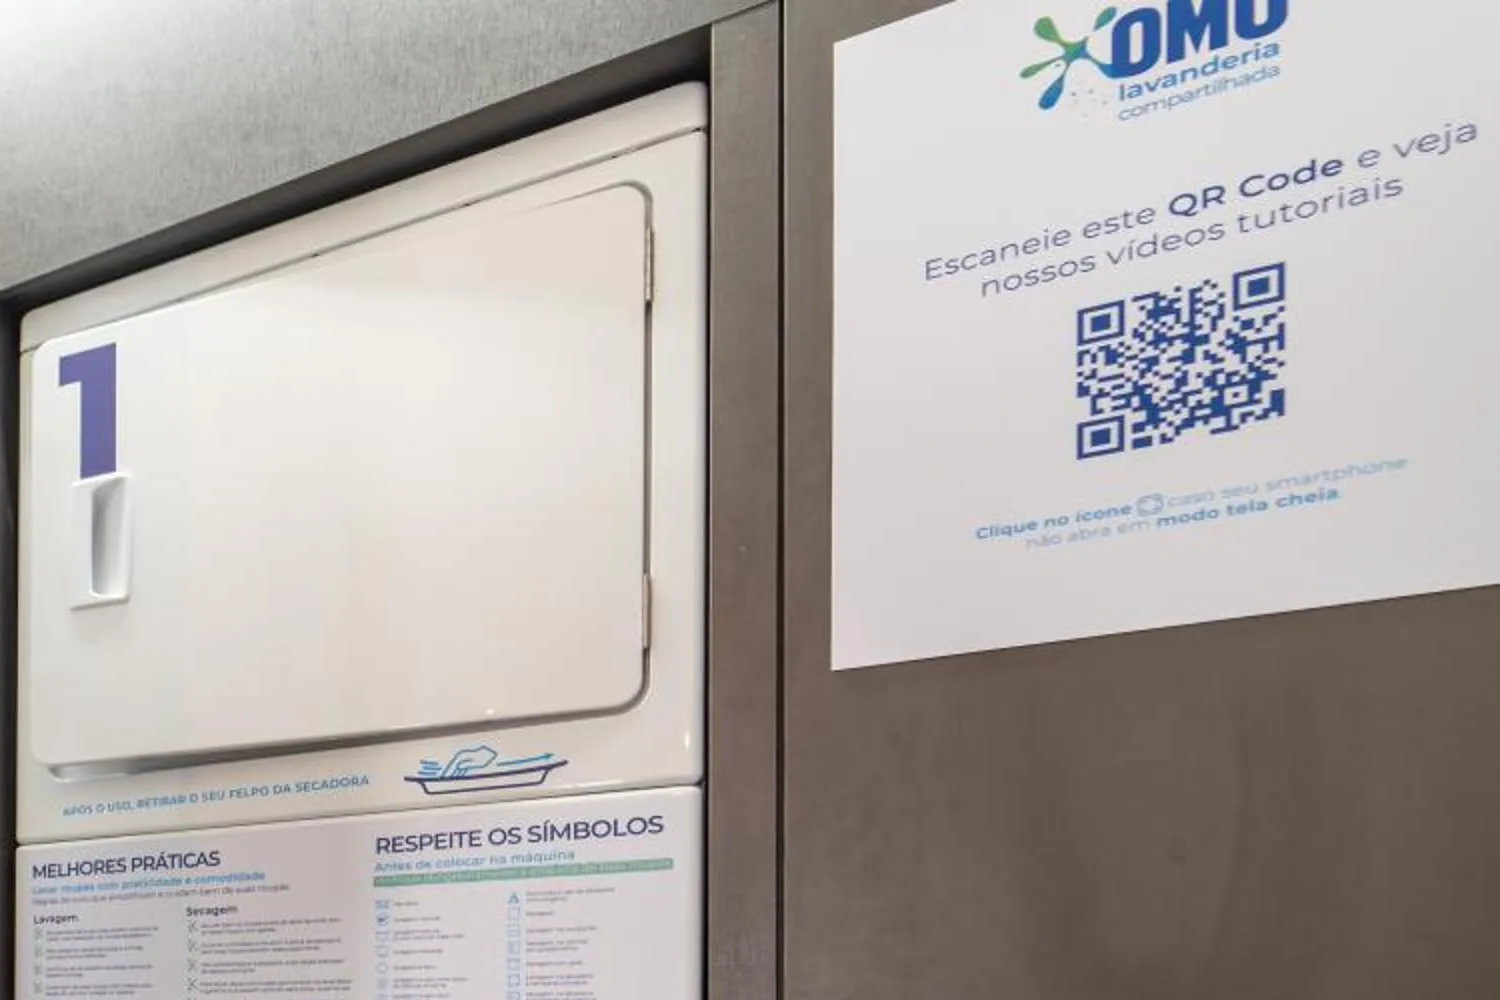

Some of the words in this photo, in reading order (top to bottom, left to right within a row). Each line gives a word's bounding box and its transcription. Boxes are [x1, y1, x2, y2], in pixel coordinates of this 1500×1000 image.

[1111, 0, 1289, 79] OMO
[1118, 64, 1281, 122] compartilhada
[1119, 41, 1281, 102] lavanderia
[924, 227, 1072, 282] Escaneie
[1082, 204, 1156, 242] este
[1168, 185, 1226, 219] QR
[1240, 157, 1343, 199] Code
[1358, 147, 1382, 170] e
[1392, 120, 1479, 160] veja
[980, 254, 1096, 299] nossos
[1107, 221, 1226, 267] vídeos
[1236, 176, 1404, 235] tutoriais
[59, 343, 117, 479] 1
[1220, 483, 1260, 501] seu
[1265, 457, 1409, 492] smartphone
[975, 520, 1038, 541] Clique
[1043, 514, 1070, 530] no
[1075, 502, 1133, 525] ícone
[1024, 529, 1062, 551] não
[1067, 522, 1112, 546] abra
[1155, 505, 1220, 530] modo
[1225, 498, 1270, 519] tela
[1275, 486, 1340, 509] cheia
[201, 790, 226, 804] SEU
[228, 785, 270, 800] FELPO
[273, 782, 292, 795] DA
[295, 775, 370, 793] SECADORA
[375, 829, 482, 856] RESPEITE
[487, 825, 522, 847] OS
[527, 814, 665, 844] SÍMBOLOS
[32, 857, 127, 881] MELHORES
[131, 849, 221, 874] PRÁTICAS
[415, 857, 433, 871] de
[435, 853, 486, 870] colocar
[510, 848, 575, 867] máquina
[33, 913, 79, 926] Lavagem
[186, 904, 239, 918] Secagem
